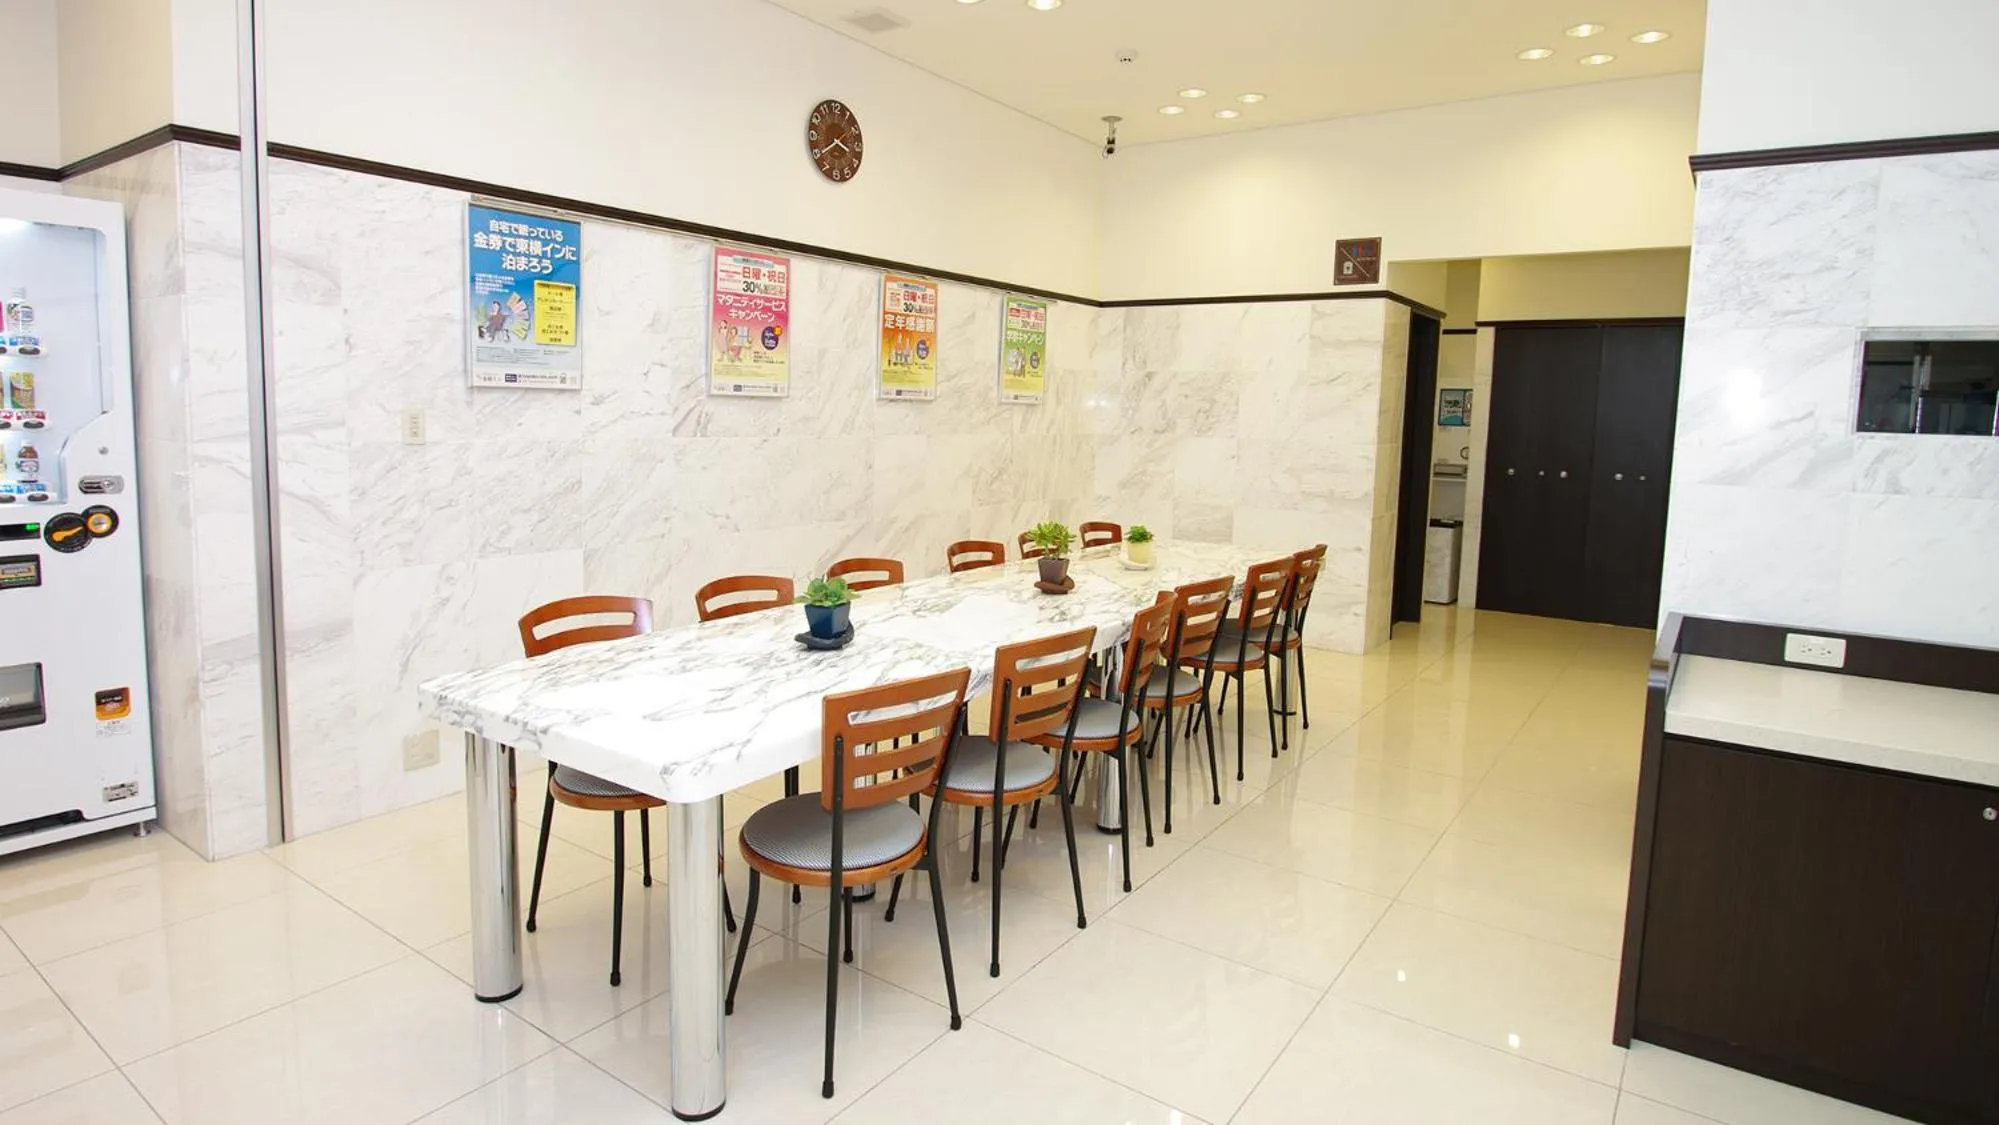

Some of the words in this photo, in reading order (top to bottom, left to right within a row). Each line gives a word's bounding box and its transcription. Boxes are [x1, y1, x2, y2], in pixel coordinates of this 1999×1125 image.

[820, 104, 829, 115] 11
[831, 103, 841, 114] 12
[851, 124, 859, 137] 2
[822, 161, 830, 172] 7
[843, 167, 852, 178] 5
[489, 219, 564, 241] 自宅で眠っている
[473, 231, 577, 260] 金券で東横インに
[501, 253, 553, 274] 泊まろう
[742, 266, 786, 284] 日曜・祝日
[717, 294, 787, 312] マタニティサービス
[729, 308, 775, 322] キャンペーン
